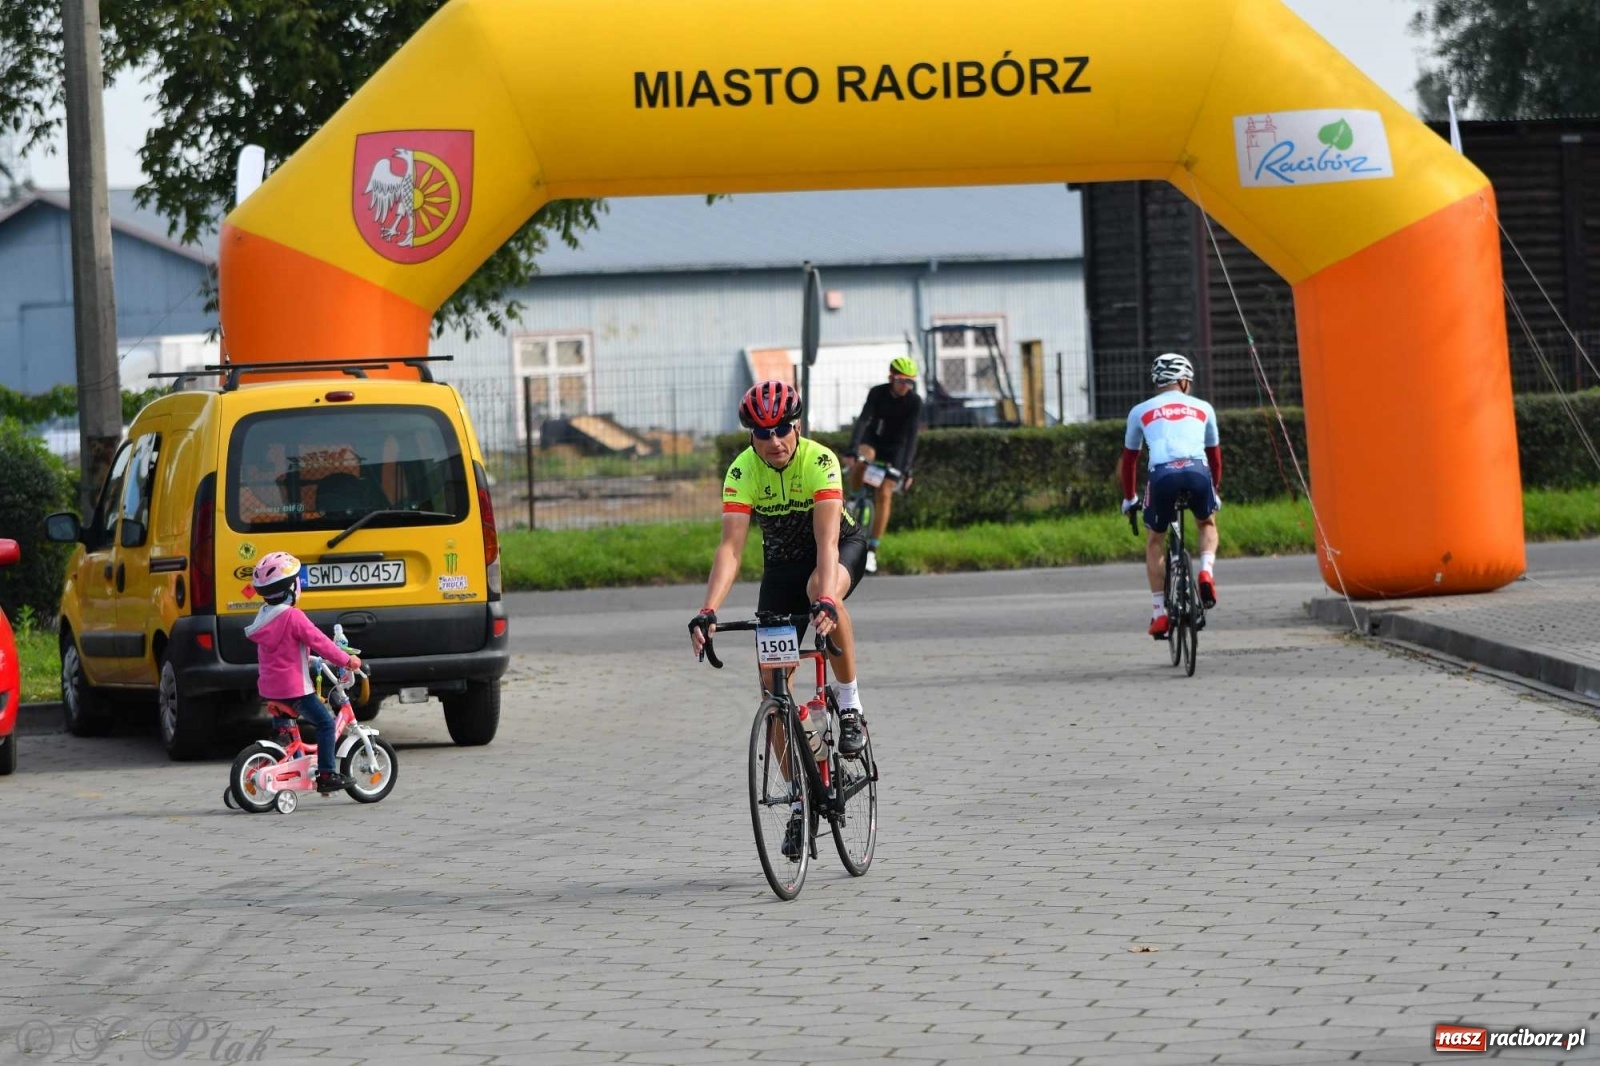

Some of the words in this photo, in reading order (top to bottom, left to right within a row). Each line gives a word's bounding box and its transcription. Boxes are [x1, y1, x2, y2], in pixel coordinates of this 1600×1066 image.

[633, 66, 820, 109] MIASTO
[836, 50, 1092, 103] RACIBÓRZ
[1153, 406, 1197, 420] Alpecin
[308, 566, 343, 585] SWD
[349, 563, 402, 583] 60457
[760, 640, 797, 653] 1501
